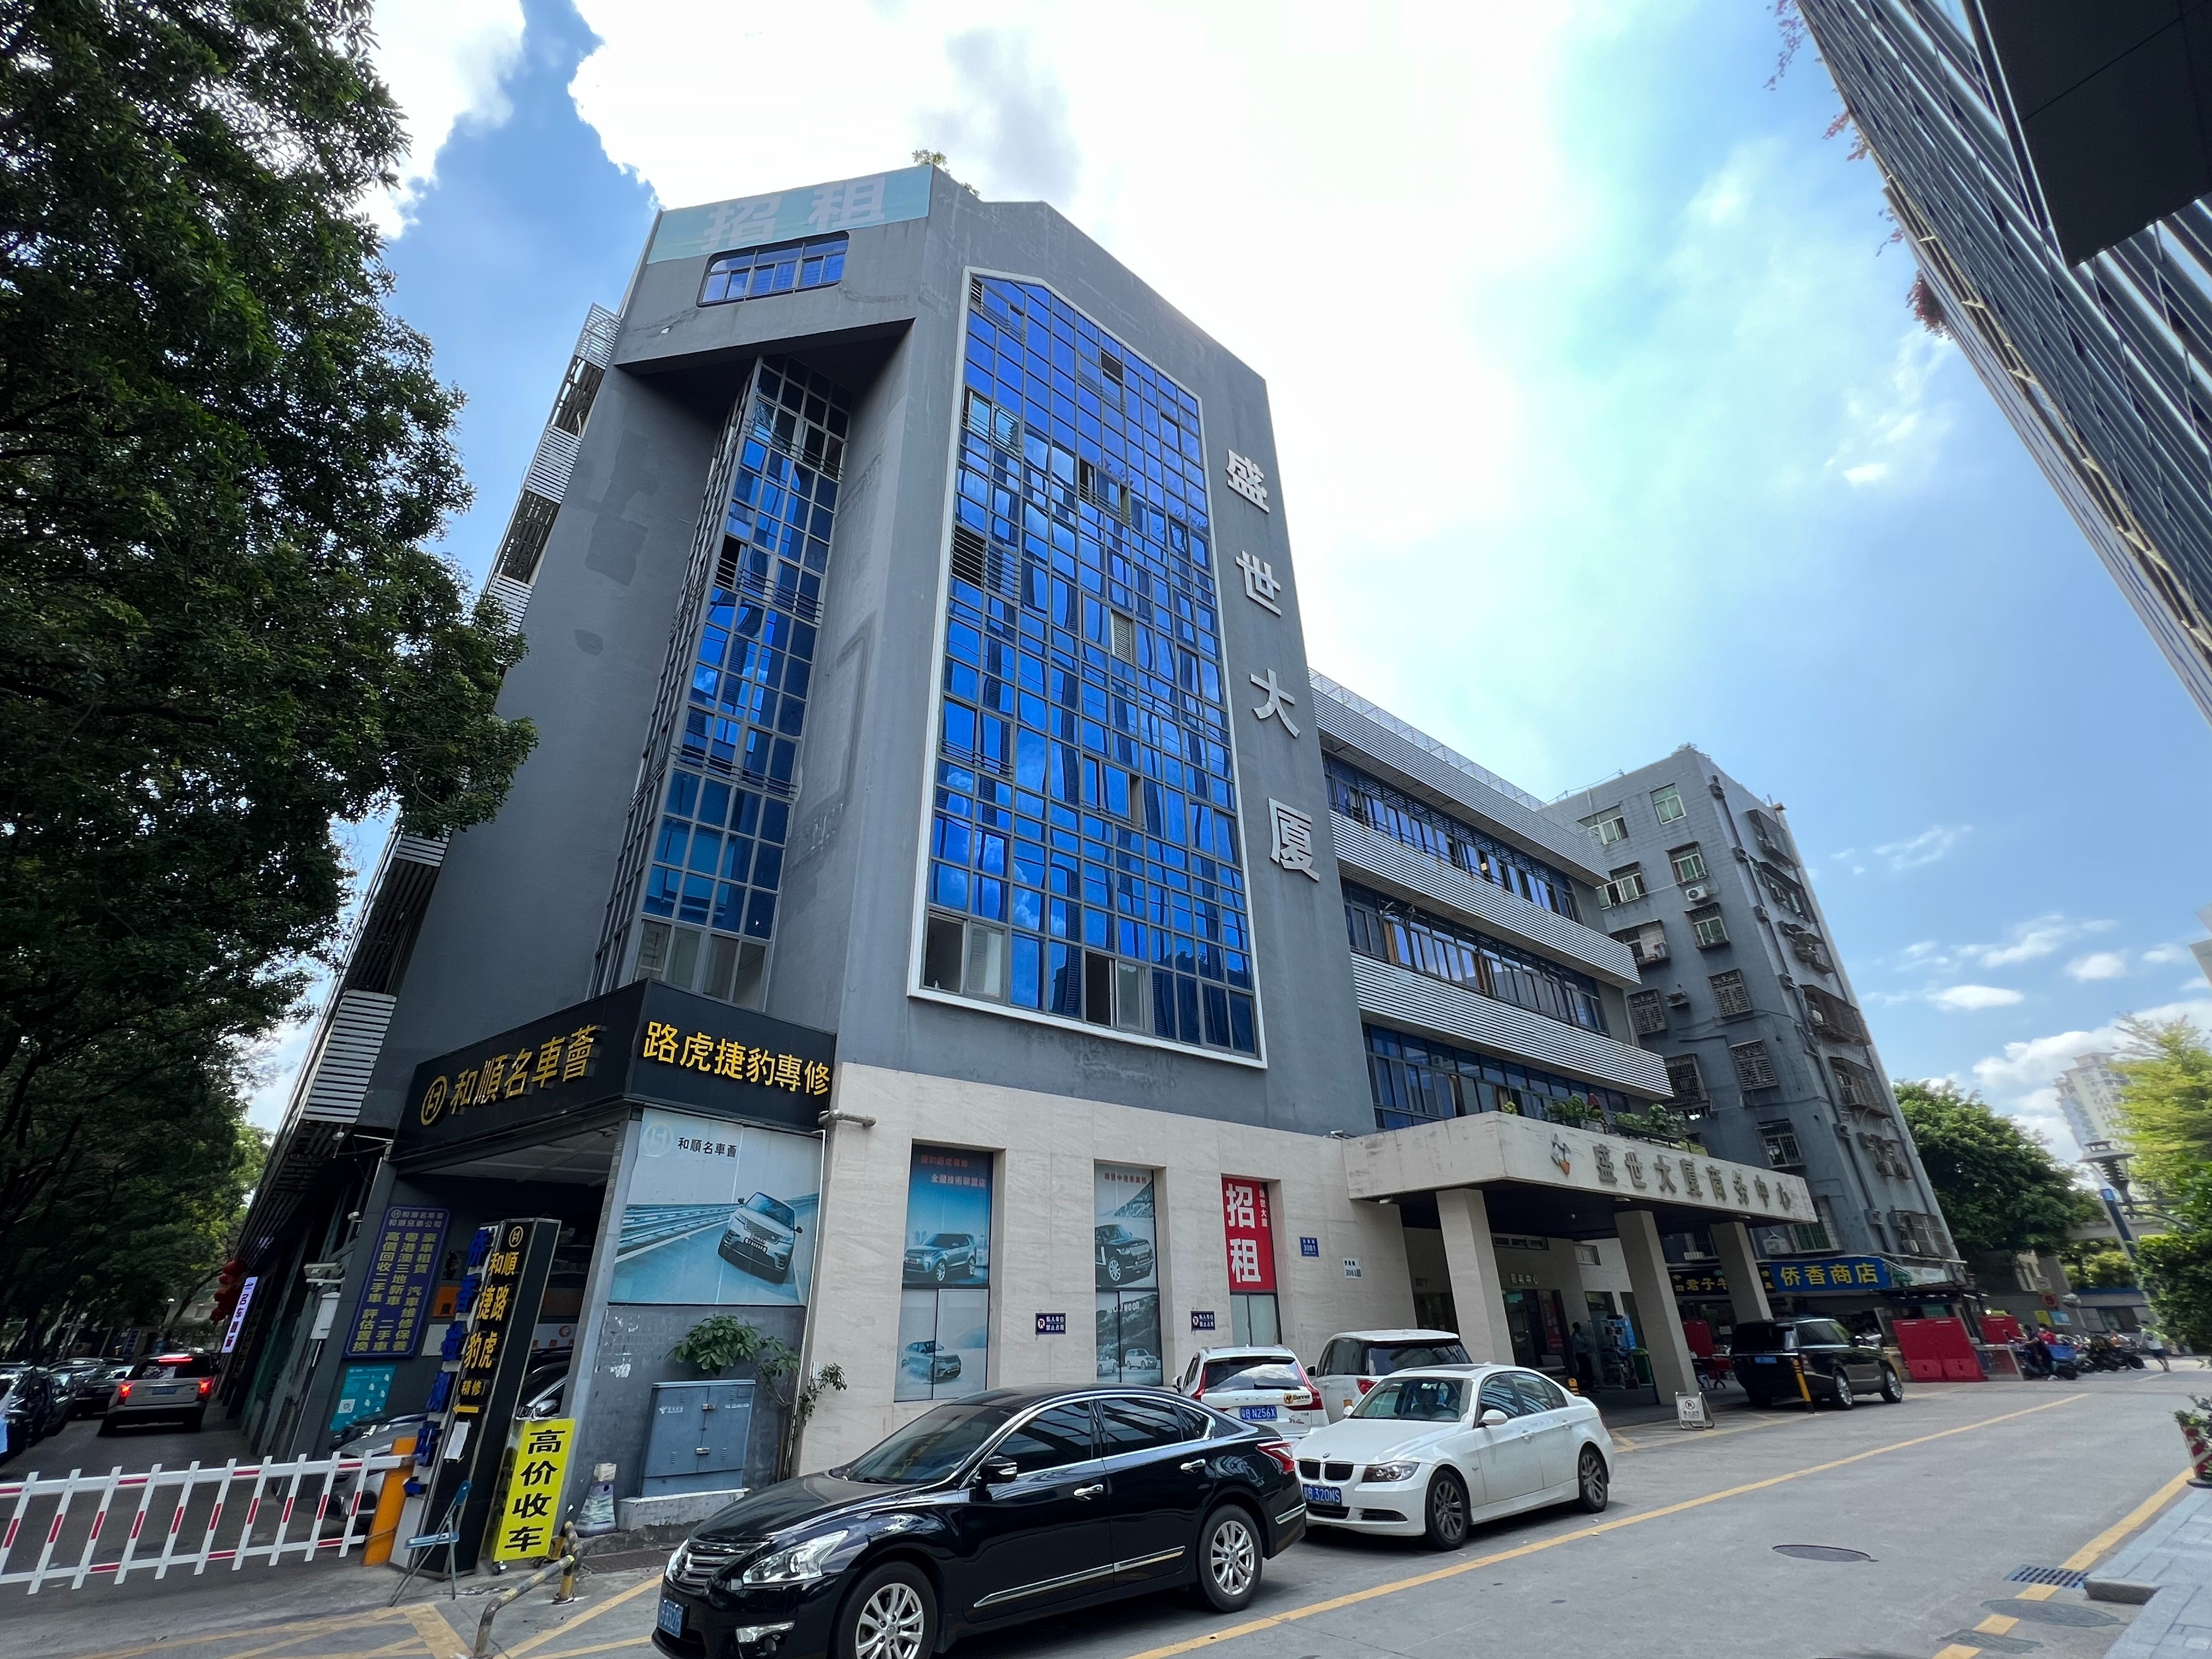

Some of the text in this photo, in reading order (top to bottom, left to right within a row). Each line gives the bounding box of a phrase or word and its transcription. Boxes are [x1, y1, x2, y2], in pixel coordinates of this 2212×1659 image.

[701, 177, 886, 251] 招租
[1227, 449, 1319, 882] 盛世大厦
[450, 1024, 600, 1116] 和順名車薈
[643, 1020, 831, 1096] 路虎捷豹專修
[1593, 1143, 1792, 1211] 盛世大厦商务中心
[488, 1251, 520, 1276] 和順
[1226, 1183, 1261, 1283] 招租
[1780, 1262, 1879, 1286] 侨香商店
[504, 1429, 566, 1553] 高价收车
